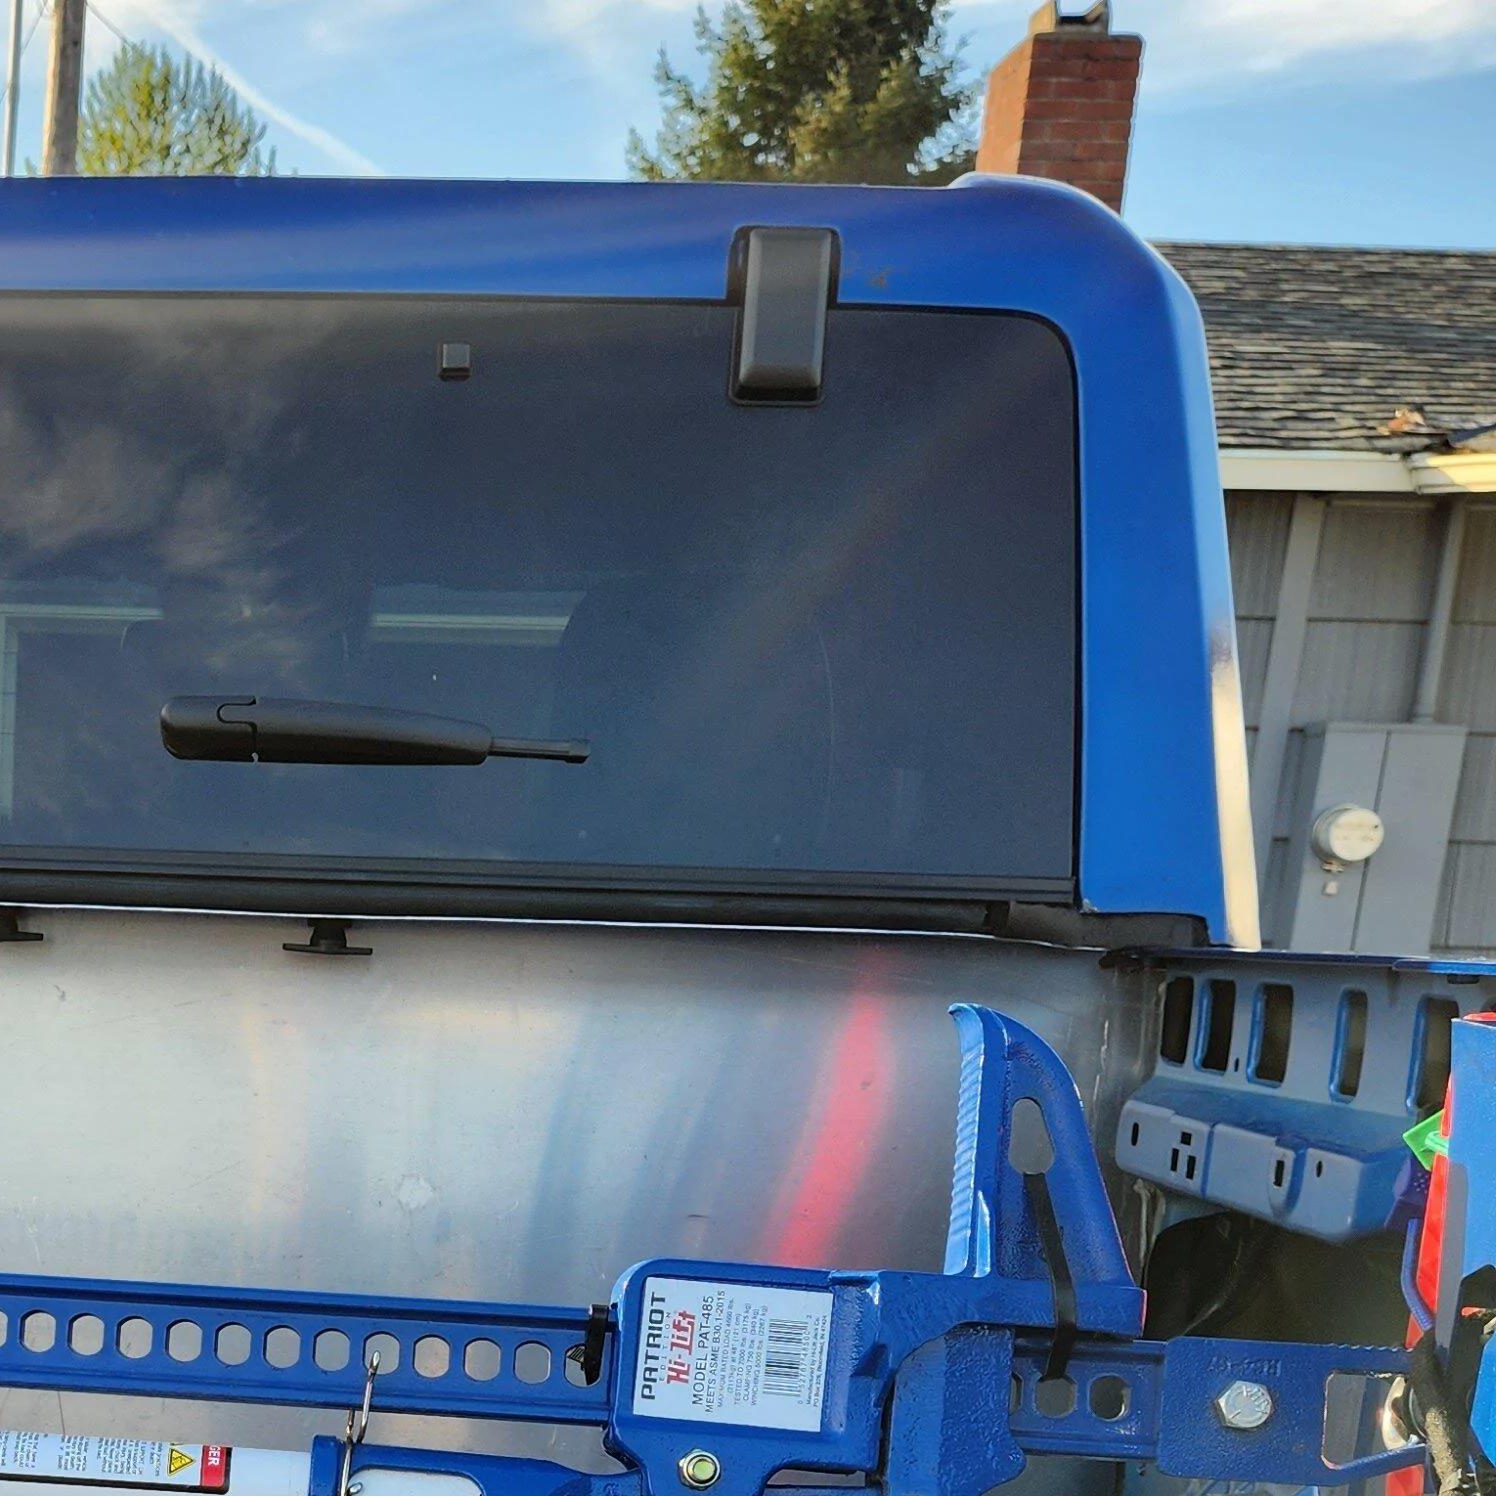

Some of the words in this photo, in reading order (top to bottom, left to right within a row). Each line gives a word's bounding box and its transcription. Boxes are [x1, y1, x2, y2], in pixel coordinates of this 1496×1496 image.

[641, 1292, 665, 1399] PATRIOT
[667, 1310, 696, 1384] Hi-Lift
[697, 1295, 713, 1348] PAT-485
[691, 1352, 707, 1404] MODEL
[708, 1346, 719, 1375] ASME
[705, 1378, 716, 1412] MEETS
